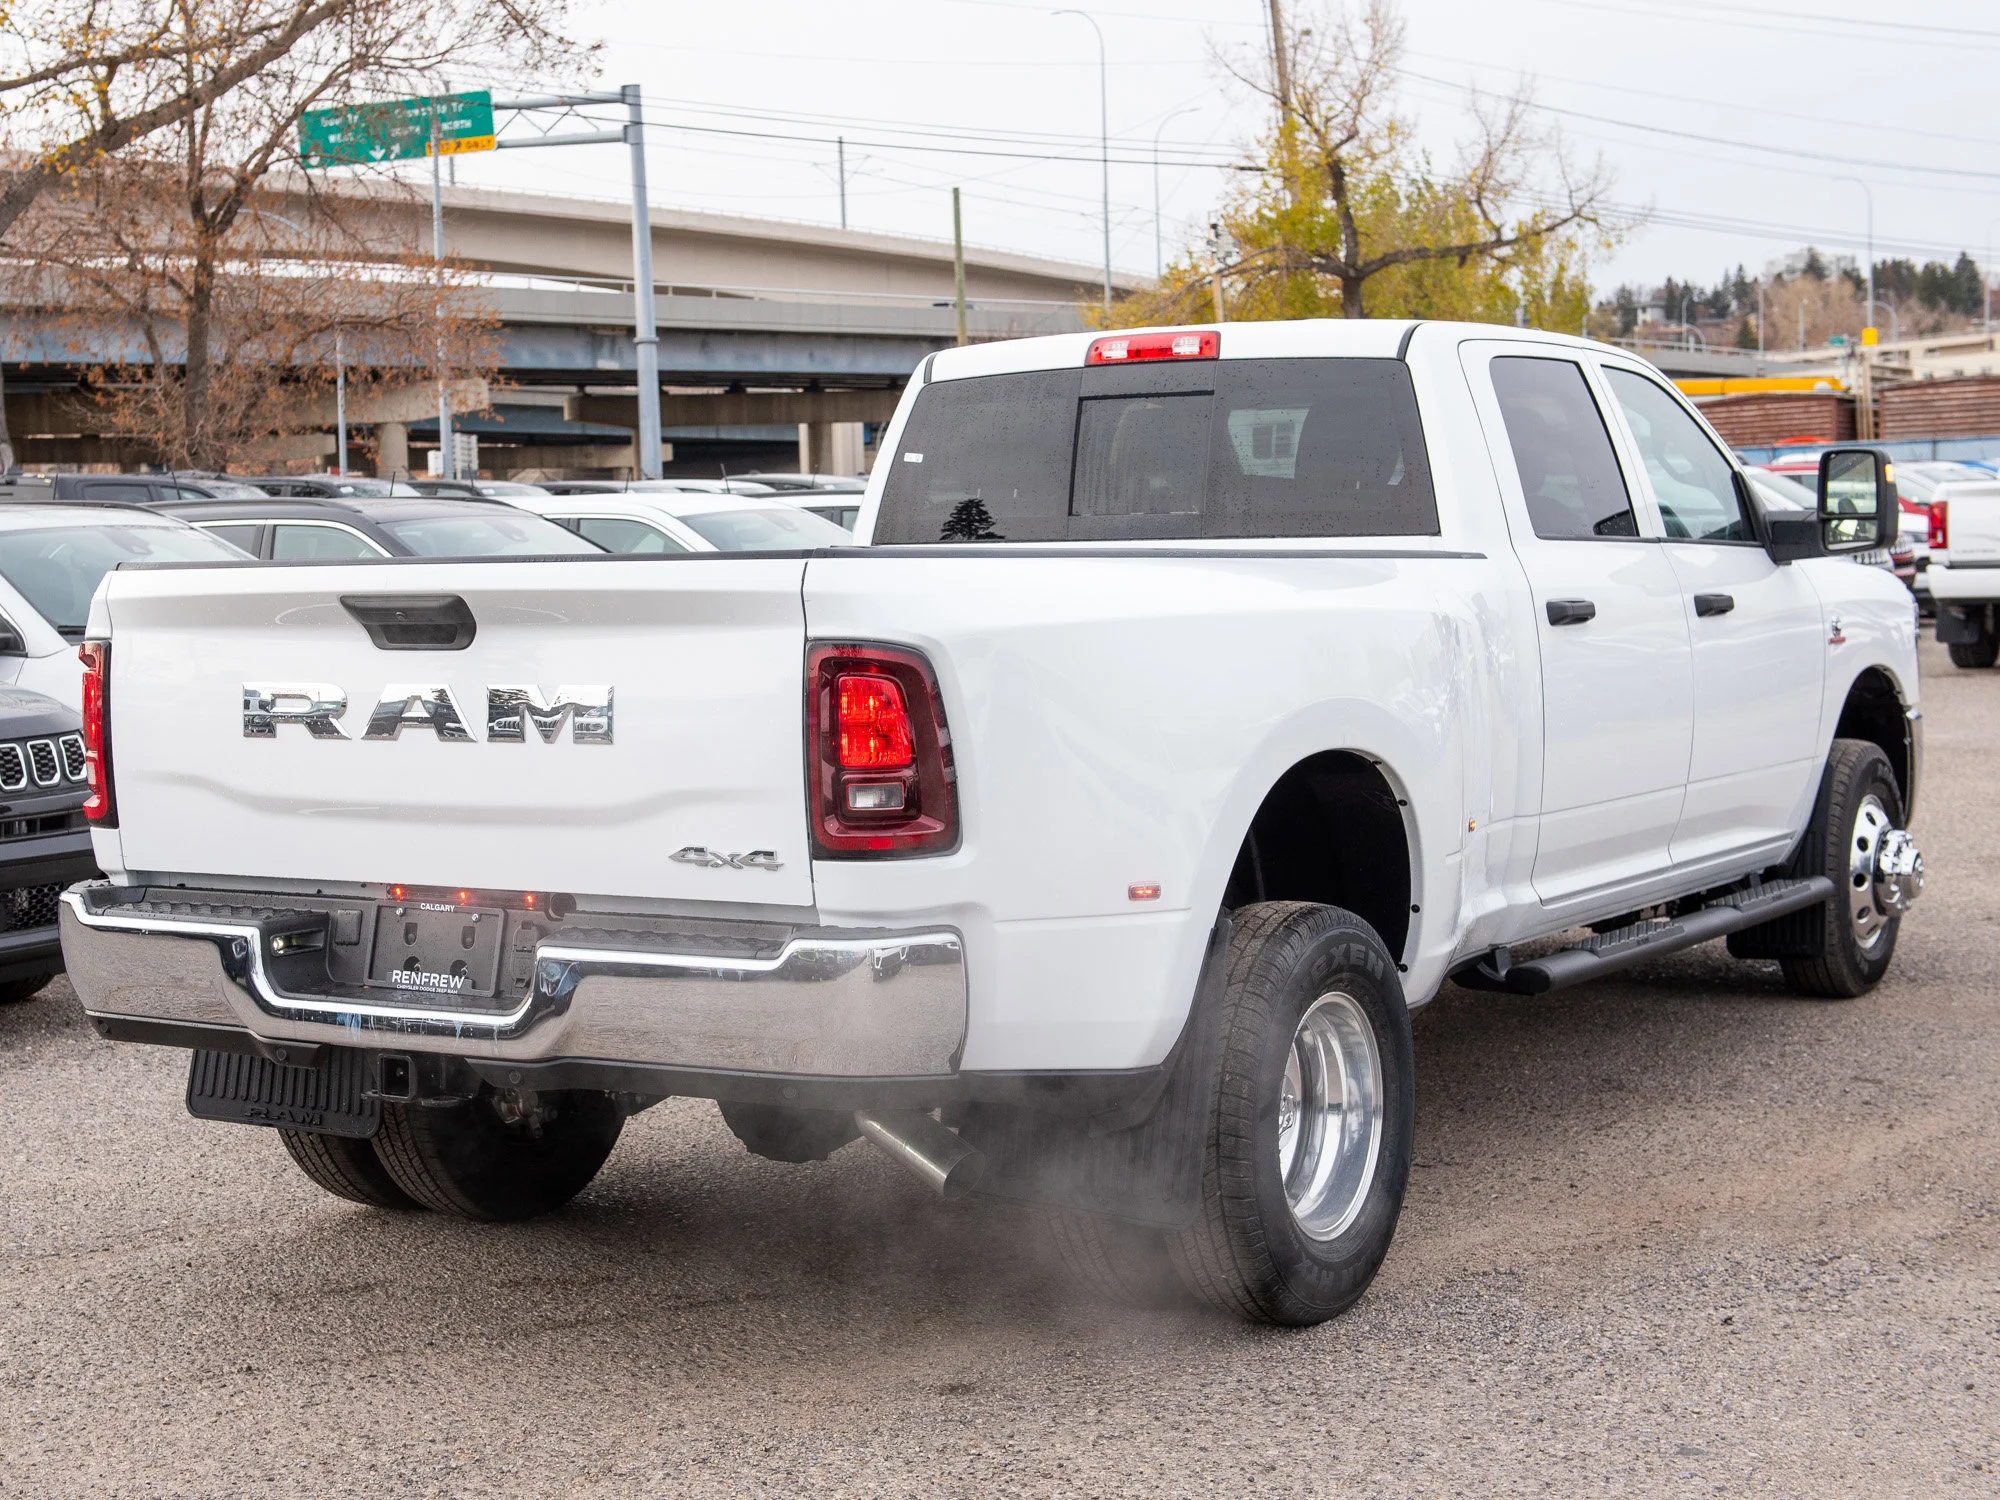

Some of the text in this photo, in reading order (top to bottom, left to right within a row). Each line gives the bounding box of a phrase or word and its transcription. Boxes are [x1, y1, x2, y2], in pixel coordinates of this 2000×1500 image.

[451, 102, 464, 113] Tr
[242, 681, 615, 745] RAM
[668, 845, 784, 872] 4x4
[420, 902, 455, 912] CALGARY
[391, 969, 465, 989] RENFREW
[244, 1106, 323, 1126] RAM
